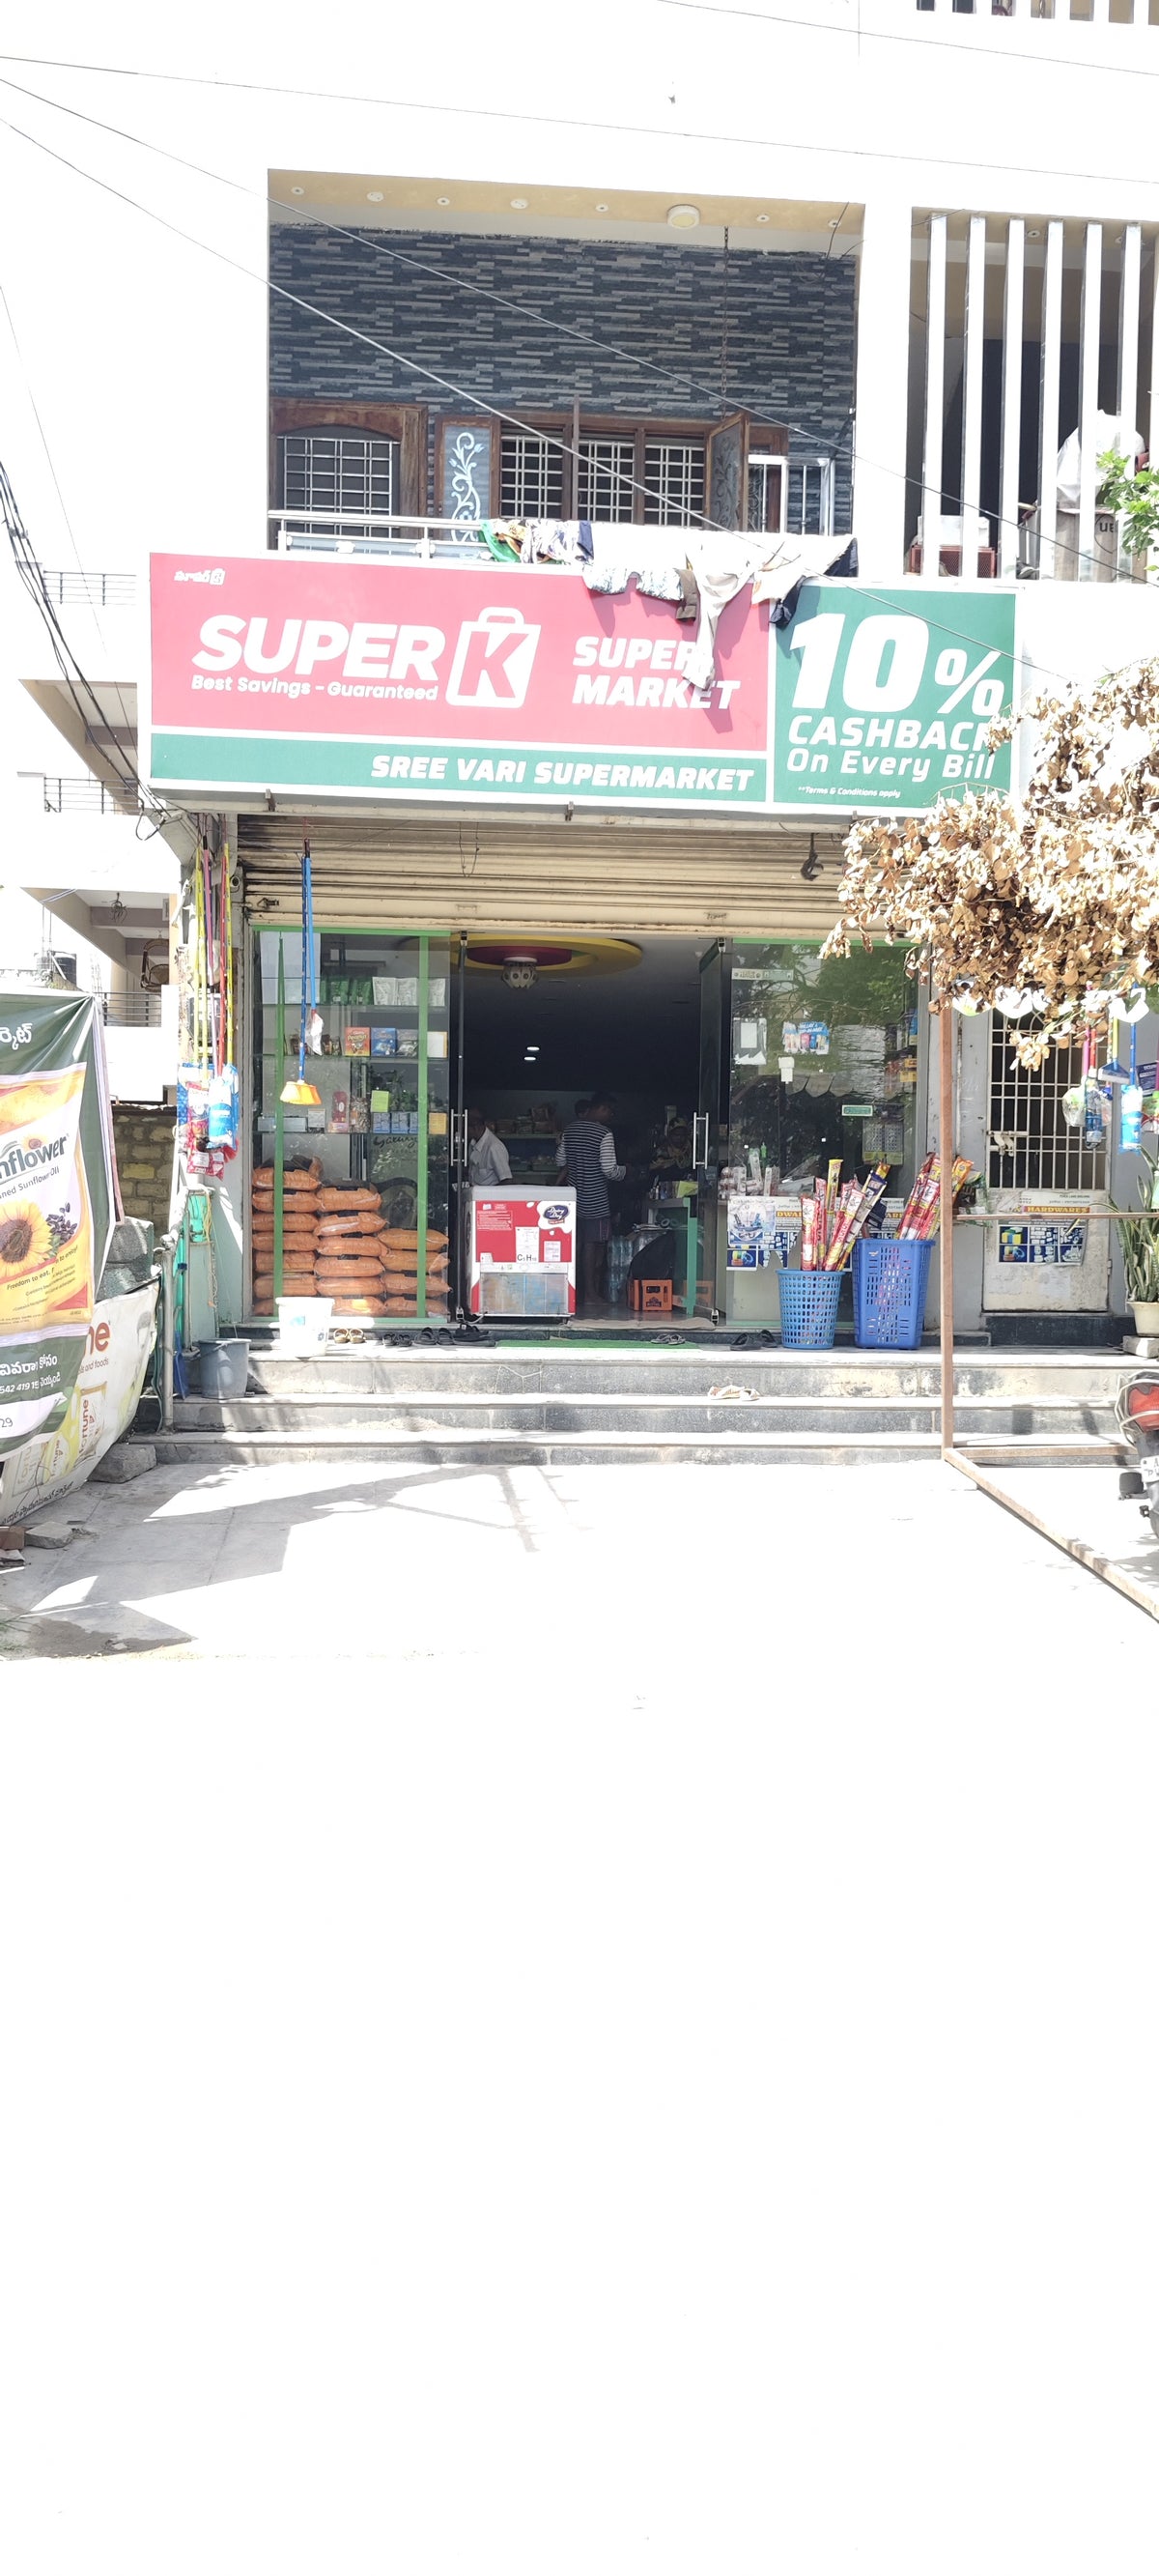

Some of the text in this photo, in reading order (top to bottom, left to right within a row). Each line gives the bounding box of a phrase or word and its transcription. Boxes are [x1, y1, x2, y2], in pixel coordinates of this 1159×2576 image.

[191, 615, 446, 681] SUPER
[573, 636, 697, 671] SUPER
[191, 675, 233, 692] Best
[238, 677, 311, 700] Savings
[327, 682, 438, 701] Guaranteed
[572, 674, 741, 709] MARKET
[371, 756, 754, 791] SREE VARI SUPERMARKET
[786, 748, 995, 783] On Every Bill
[837, 787, 877, 796] Conditions
[879, 789, 901, 798] apply
[0, 1186, 16, 1198] ned
